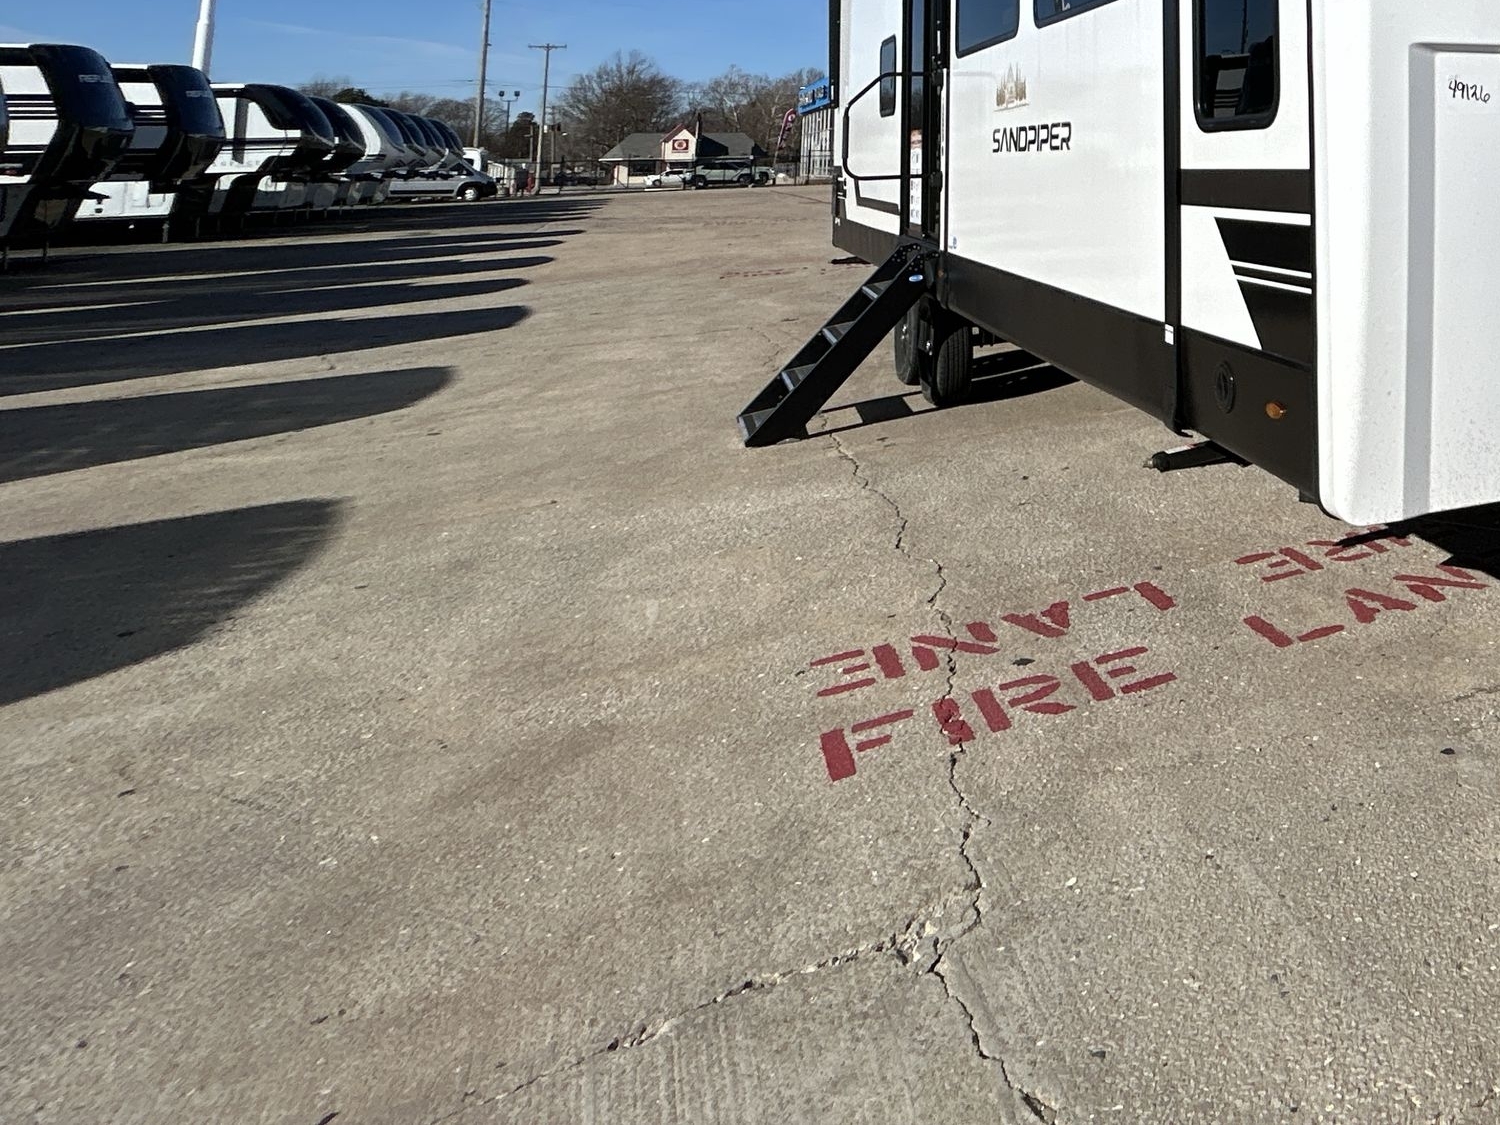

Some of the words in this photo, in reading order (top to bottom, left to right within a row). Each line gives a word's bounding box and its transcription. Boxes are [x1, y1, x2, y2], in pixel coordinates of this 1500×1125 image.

[1448, 79, 1491, 103] 49126
[992, 121, 1072, 153] SANDPIPER
[810, 582, 1177, 697] LANE
[819, 646, 1179, 781] FIRE
[1243, 564, 1490, 648] LAN
